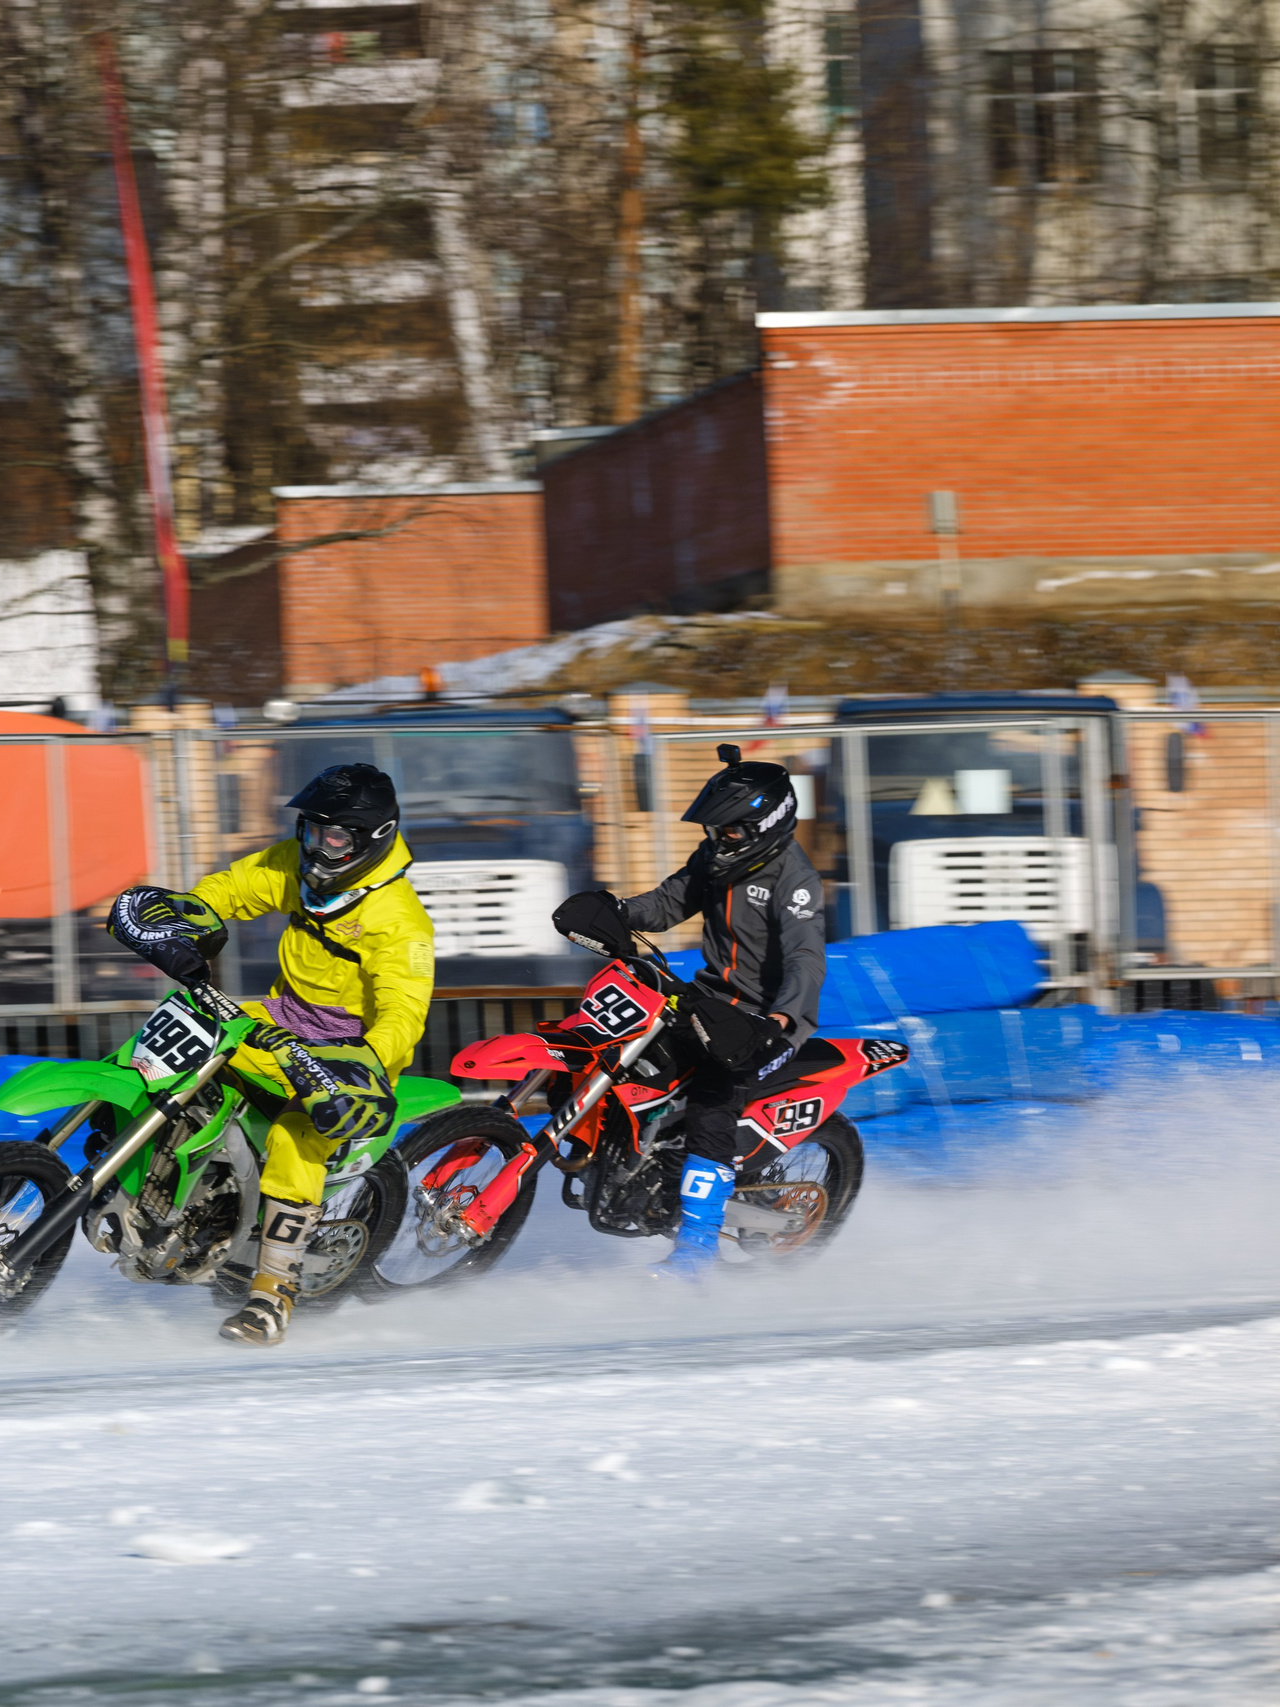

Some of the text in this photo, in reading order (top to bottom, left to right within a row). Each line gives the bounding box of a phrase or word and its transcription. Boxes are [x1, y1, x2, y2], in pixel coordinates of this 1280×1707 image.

[120, 894, 173, 941] MONSTER ARMY
[580, 984, 649, 1037] 99
[138, 1009, 212, 1075] 999
[630, 1086, 648, 1097] QTM
[772, 1098, 824, 1138] 99
[680, 1169, 717, 1200] G
[266, 1211, 307, 1244] G
